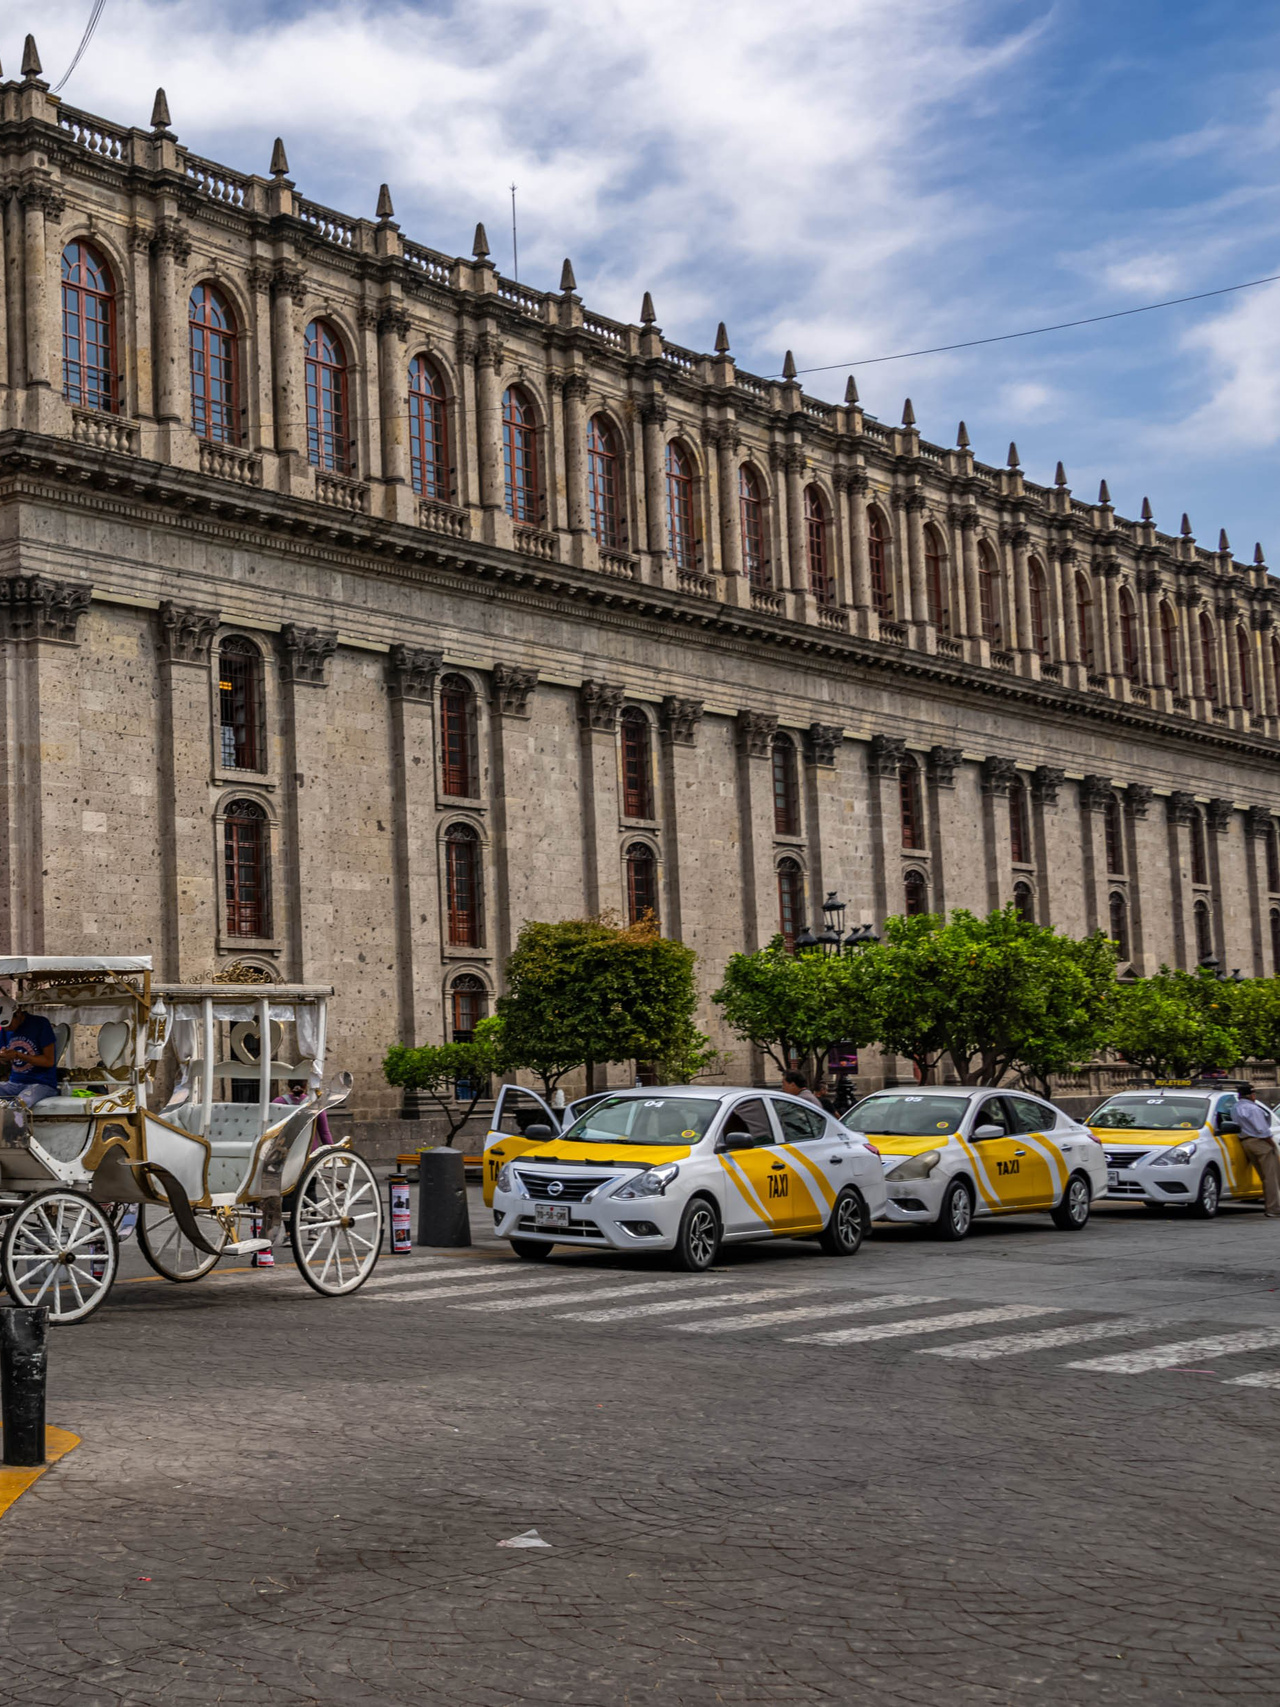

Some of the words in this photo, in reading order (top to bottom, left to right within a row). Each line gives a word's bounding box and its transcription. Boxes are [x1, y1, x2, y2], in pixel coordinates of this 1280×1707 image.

[643, 1100, 665, 1108] 04
[996, 1159, 1020, 1176] TAXI
[767, 1173, 789, 1199] TAXI
